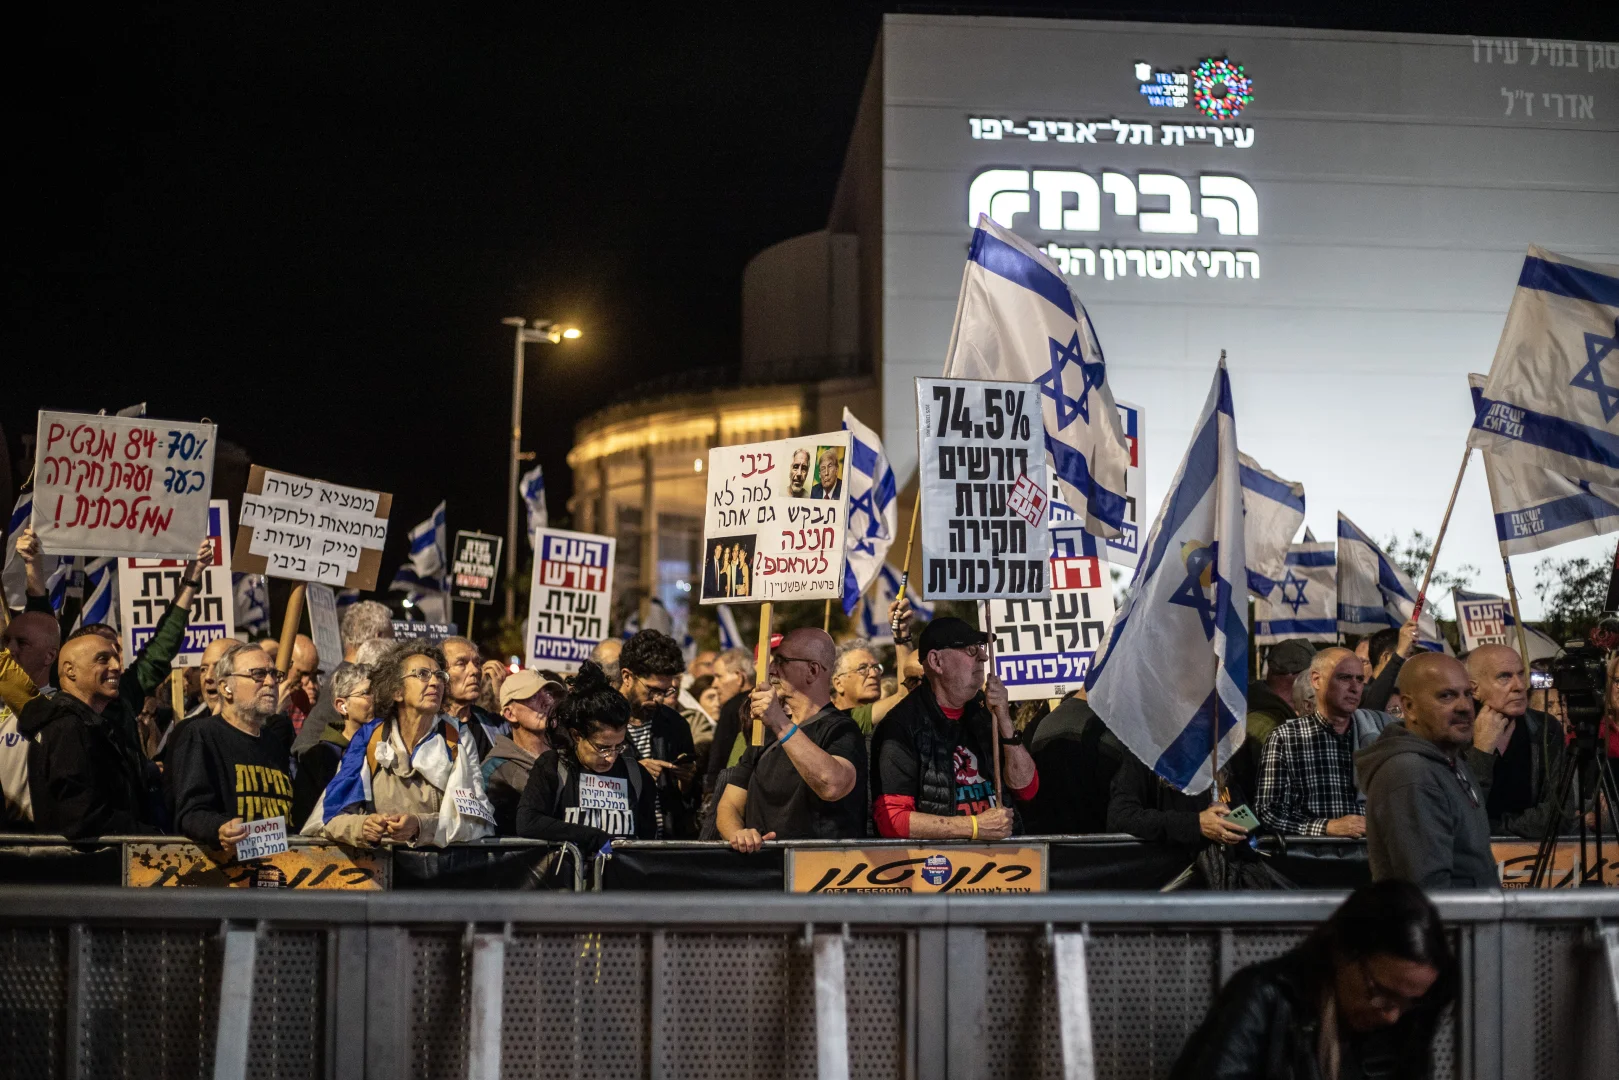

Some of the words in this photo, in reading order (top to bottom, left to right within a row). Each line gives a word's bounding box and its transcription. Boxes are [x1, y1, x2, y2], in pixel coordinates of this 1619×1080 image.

[1543, 93, 1595, 119] אדרי
[1161, 124, 1254, 148] עיריית
[1100, 249, 1260, 280] התיאטרון
[932, 386, 1031, 441] 74.5%
[47, 423, 116, 462] מנדטים
[124, 428, 157, 460] 84
[167, 430, 208, 461] 70%
[43, 456, 104, 493] חקירה
[939, 446, 1028, 481] דורשים
[103, 461, 153, 493] ועדת
[163, 466, 205, 495] בעד
[267, 478, 313, 499] לשרה
[319, 488, 375, 513] ממציא
[713, 479, 735, 507] לא
[742, 479, 772, 503] למה
[955, 483, 1017, 517] ועדת
[244, 502, 315, 528] ולחקירה
[318, 514, 386, 539] מחמאות
[718, 508, 750, 528] אתה
[757, 506, 776, 524] גם
[787, 506, 836, 529] תבקש
[322, 539, 358, 558] פייק
[782, 527, 835, 551] חנינה
[949, 519, 1026, 556] חקירה
[273, 554, 306, 572] ביבי
[549, 537, 602, 567] העם
[317, 561, 340, 578] רק
[544, 561, 603, 591] דורש
[928, 557, 1044, 594] ממלכתית
[1050, 559, 1092, 589] דו
[141, 571, 213, 597] ודת
[133, 597, 223, 625] חקרה
[545, 589, 597, 615] ועדת
[1004, 592, 1092, 623] ועדת
[1468, 604, 1504, 621] העם
[537, 612, 601, 639] חקירה
[995, 621, 1105, 653] חקירה
[1000, 654, 1090, 681] מלכתית
[581, 788, 604, 798] חקירה
[598, 780, 621, 789] חלאס
[607, 790, 626, 799] ועדת
[581, 797, 626, 810] ממלכתית
[255, 821, 279, 834] חלאס
[265, 832, 284, 843] ועדת
[240, 842, 286, 859] ממלכתית
